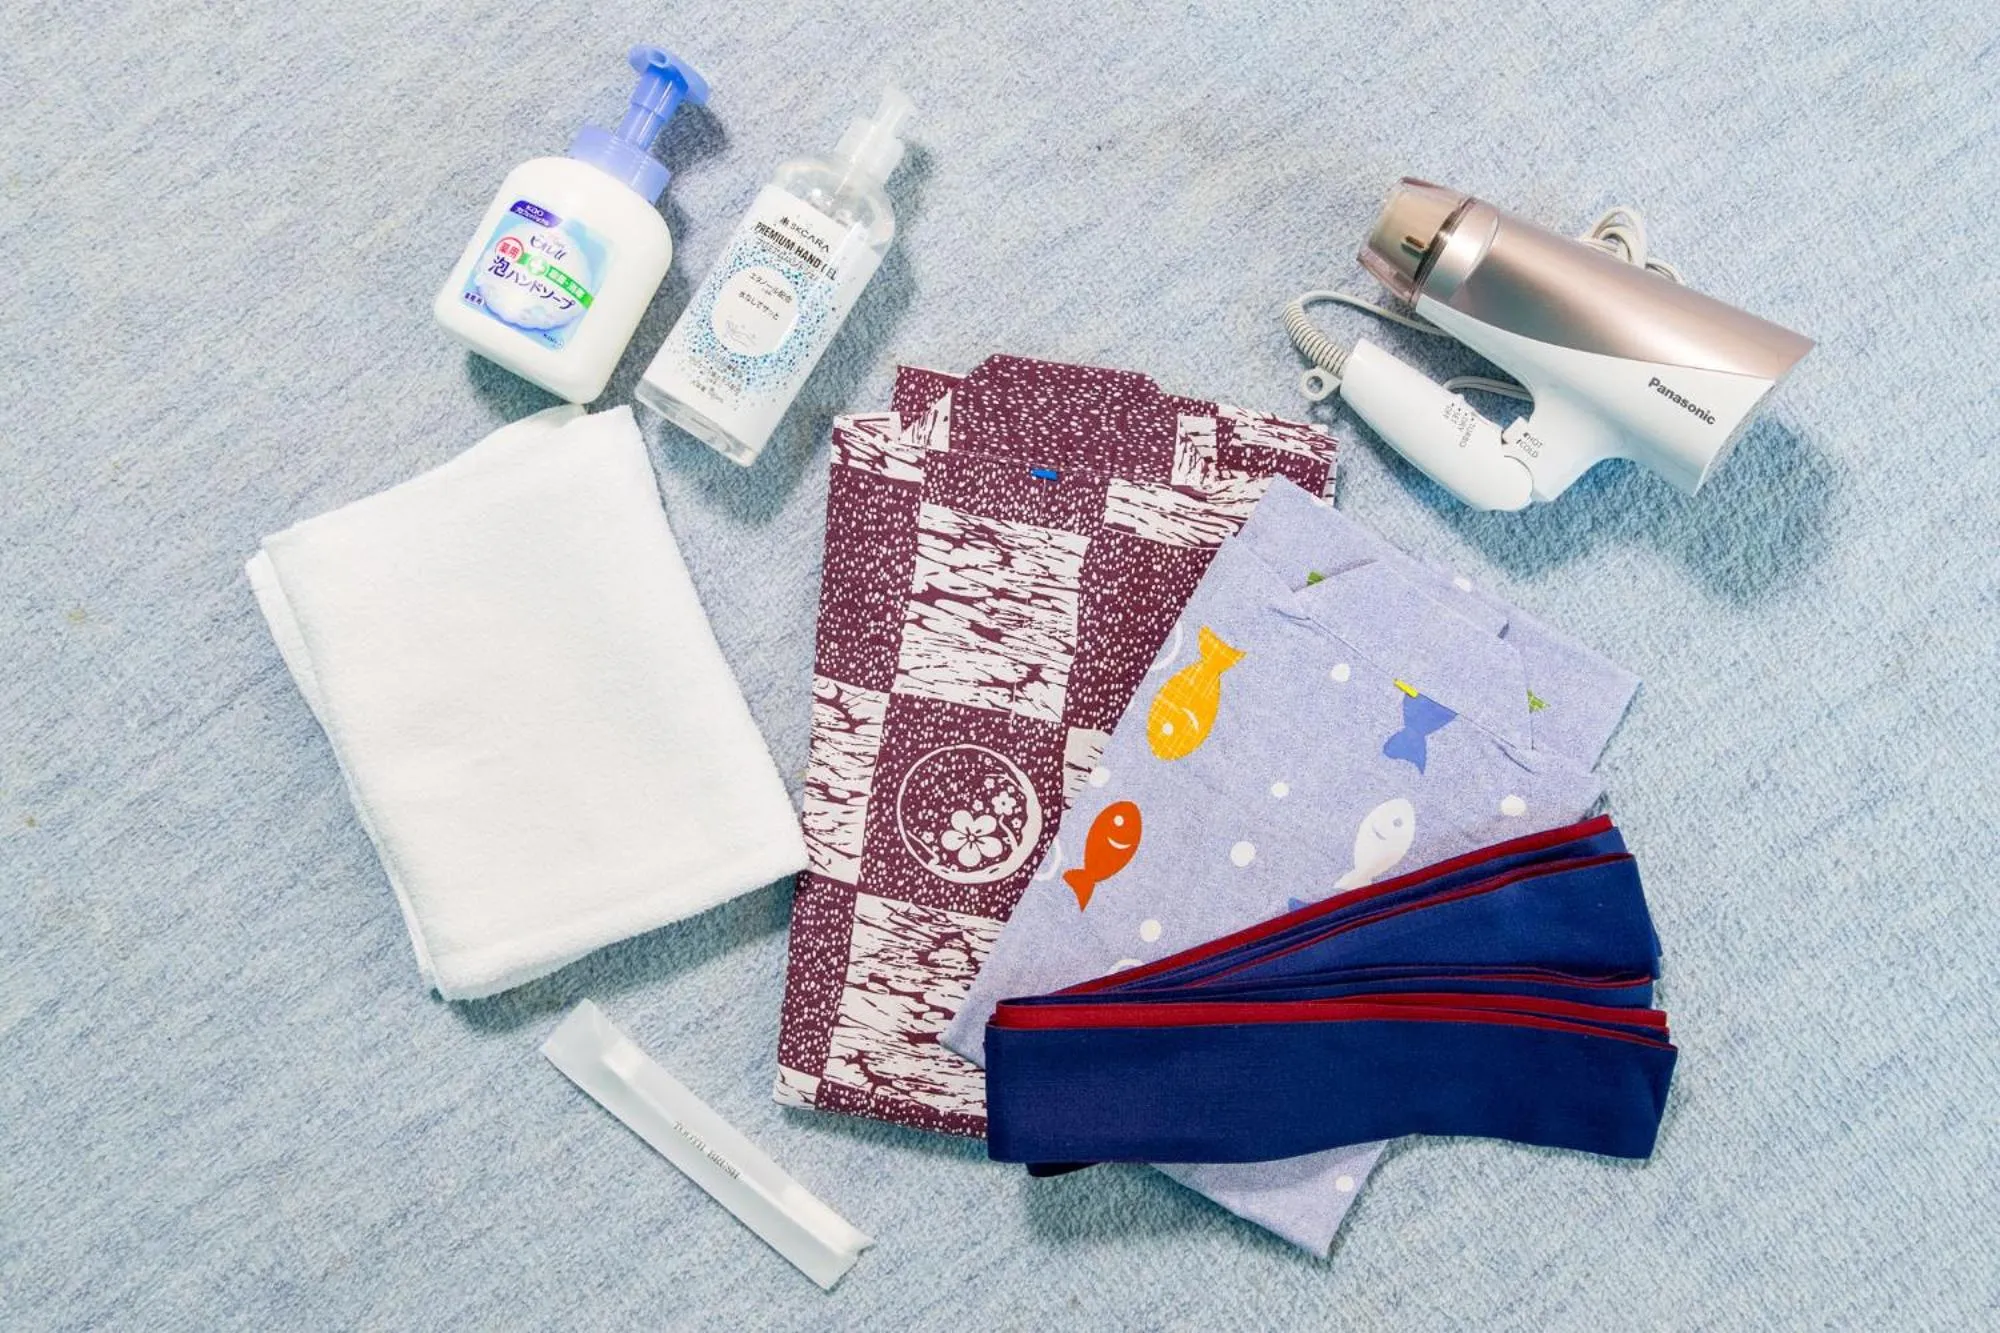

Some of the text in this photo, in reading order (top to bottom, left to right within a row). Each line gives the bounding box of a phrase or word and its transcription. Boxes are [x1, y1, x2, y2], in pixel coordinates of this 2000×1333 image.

[499, 241, 521, 260] 薬用
[754, 221, 795, 251] PREMIUM
[794, 247, 823, 269] HAND
[488, 255, 576, 311] 泡ハンドソープ
[1648, 376, 1716, 425] Panasonic
[1519, 442, 1539, 459] COLD
[706, 1149, 741, 1180] BRUSH
